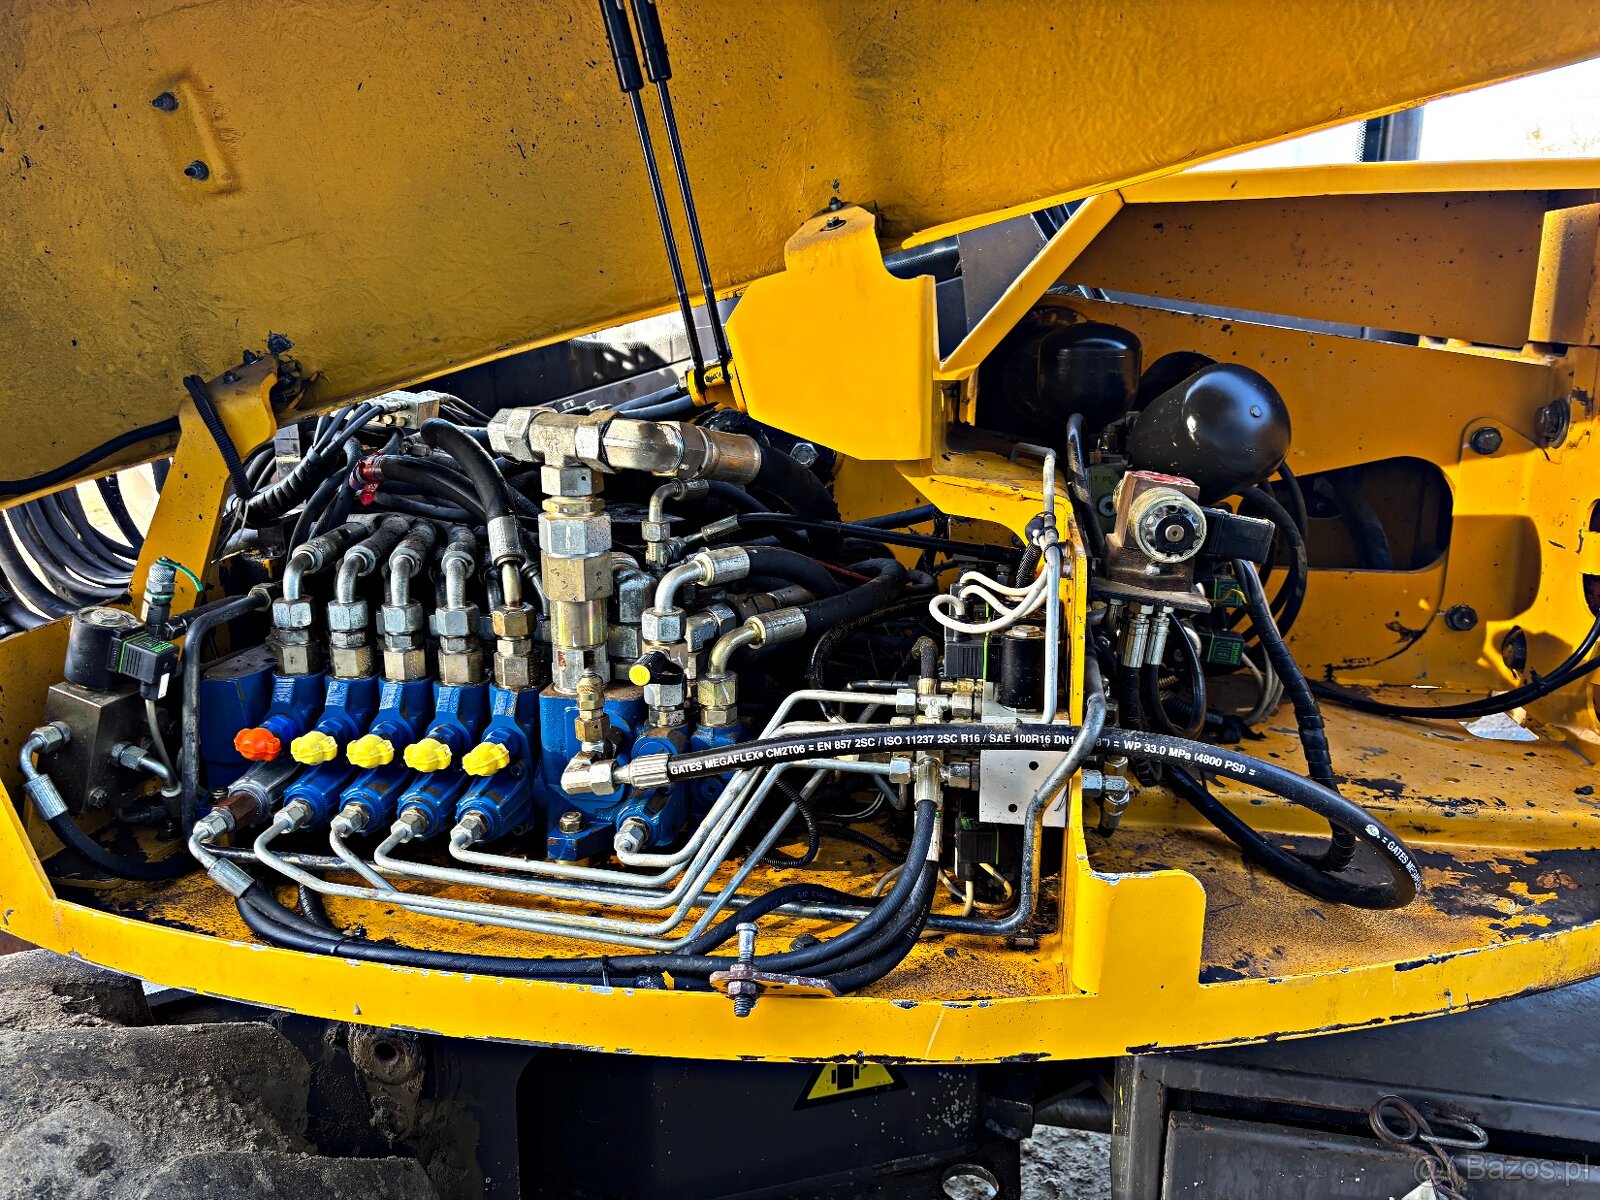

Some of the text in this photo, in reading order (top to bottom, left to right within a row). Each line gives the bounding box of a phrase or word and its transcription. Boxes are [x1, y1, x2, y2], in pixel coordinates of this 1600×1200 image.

[670, 761, 703, 775] GATES
[765, 745, 805, 758] CM2T06
[816, 740, 832, 751] EN
[834, 739, 852, 750] 857
[854, 737, 876, 748] 2SC
[884, 735, 902, 746] ISO
[905, 734, 934, 744] 11237
[937, 734, 958, 744] 2SC
[960, 733, 980, 743] R16
[989, 733, 1011, 743] SAE
[1013, 733, 1051, 744] 100R16
[1053, 734, 1078, 745] DN1
[1123, 739, 1142, 751] WP
[1143, 743, 1166, 755] 33.0
[1168, 747, 1191, 760] MPa
[1194, 752, 1222, 767] (4800
[1224, 760, 1246, 774] PSI)
[1387, 841, 1409, 864] GATES
